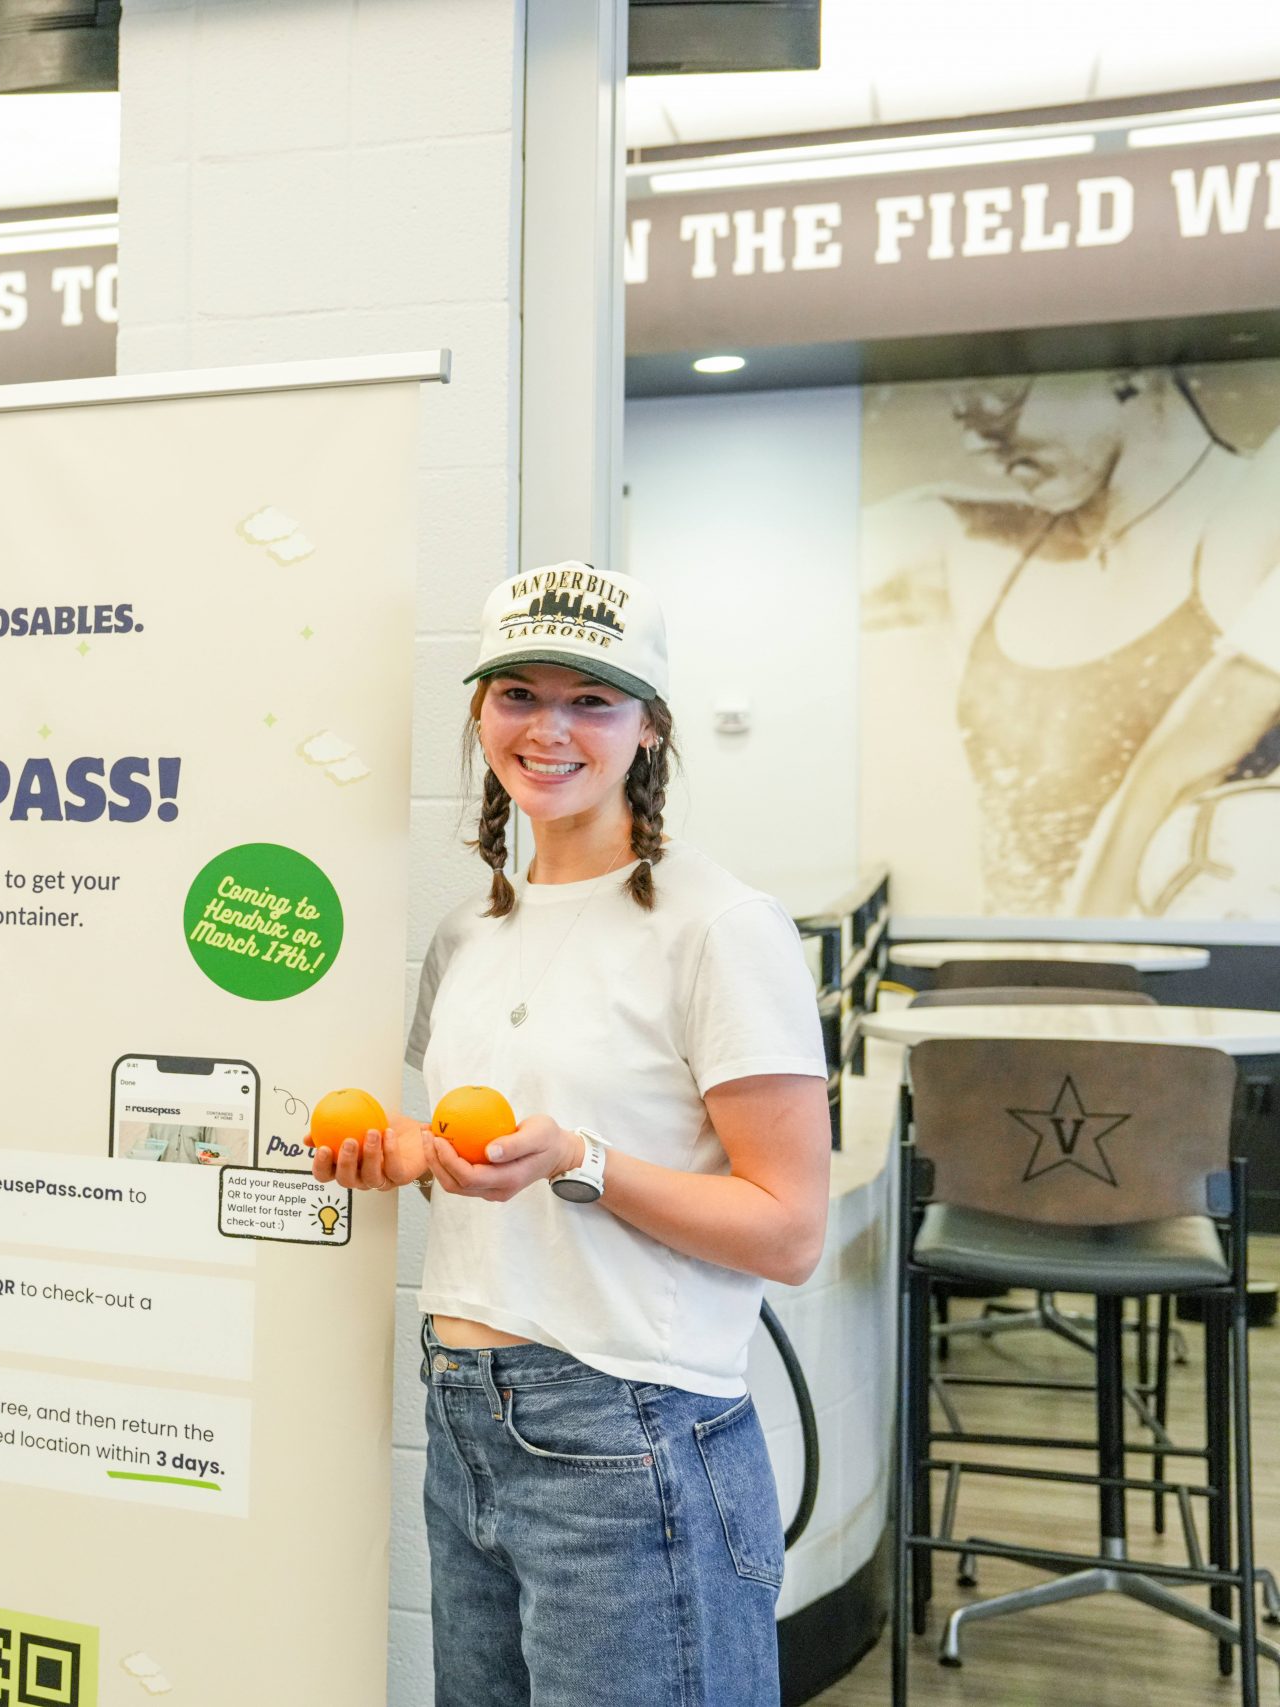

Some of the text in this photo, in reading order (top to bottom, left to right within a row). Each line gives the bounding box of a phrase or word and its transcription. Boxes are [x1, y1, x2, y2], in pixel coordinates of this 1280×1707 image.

[680, 202, 842, 279] THE
[874, 175, 1134, 264] FIELD
[511, 571, 629, 608] VANDERBILT
[507, 625, 611, 647] LACROSSE
[5, 870, 26, 888] to
[32, 871, 65, 893] get
[71, 874, 120, 894] your
[217, 876, 320, 920] Coming to
[204, 898, 322, 948] Hendrix on
[190, 920, 325, 974] March 17th!
[131, 1105, 181, 1116] reusepass
[266, 1135, 304, 1157] Pro
[1050, 1118, 1085, 1154] V
[129, 1187, 147, 1204] to
[227, 1190, 306, 1205] QR to your Apple
[228, 1177, 325, 1191] Add your ReusePass
[226, 1217, 275, 1229] check-out
[227, 1203, 302, 1217] Wallet for faster
[21, 1280, 37, 1298] to
[42, 1284, 135, 1310] check-out
[140, 1297, 152, 1311] a
[36, 1402, 70, 1424] and
[76, 1409, 116, 1431] then
[121, 1415, 179, 1439] return
[183, 1421, 215, 1443] the
[21, 1430, 91, 1457] location
[96, 1443, 151, 1465] within
[156, 1450, 168, 1467] 3
[172, 1453, 226, 1478] days.
